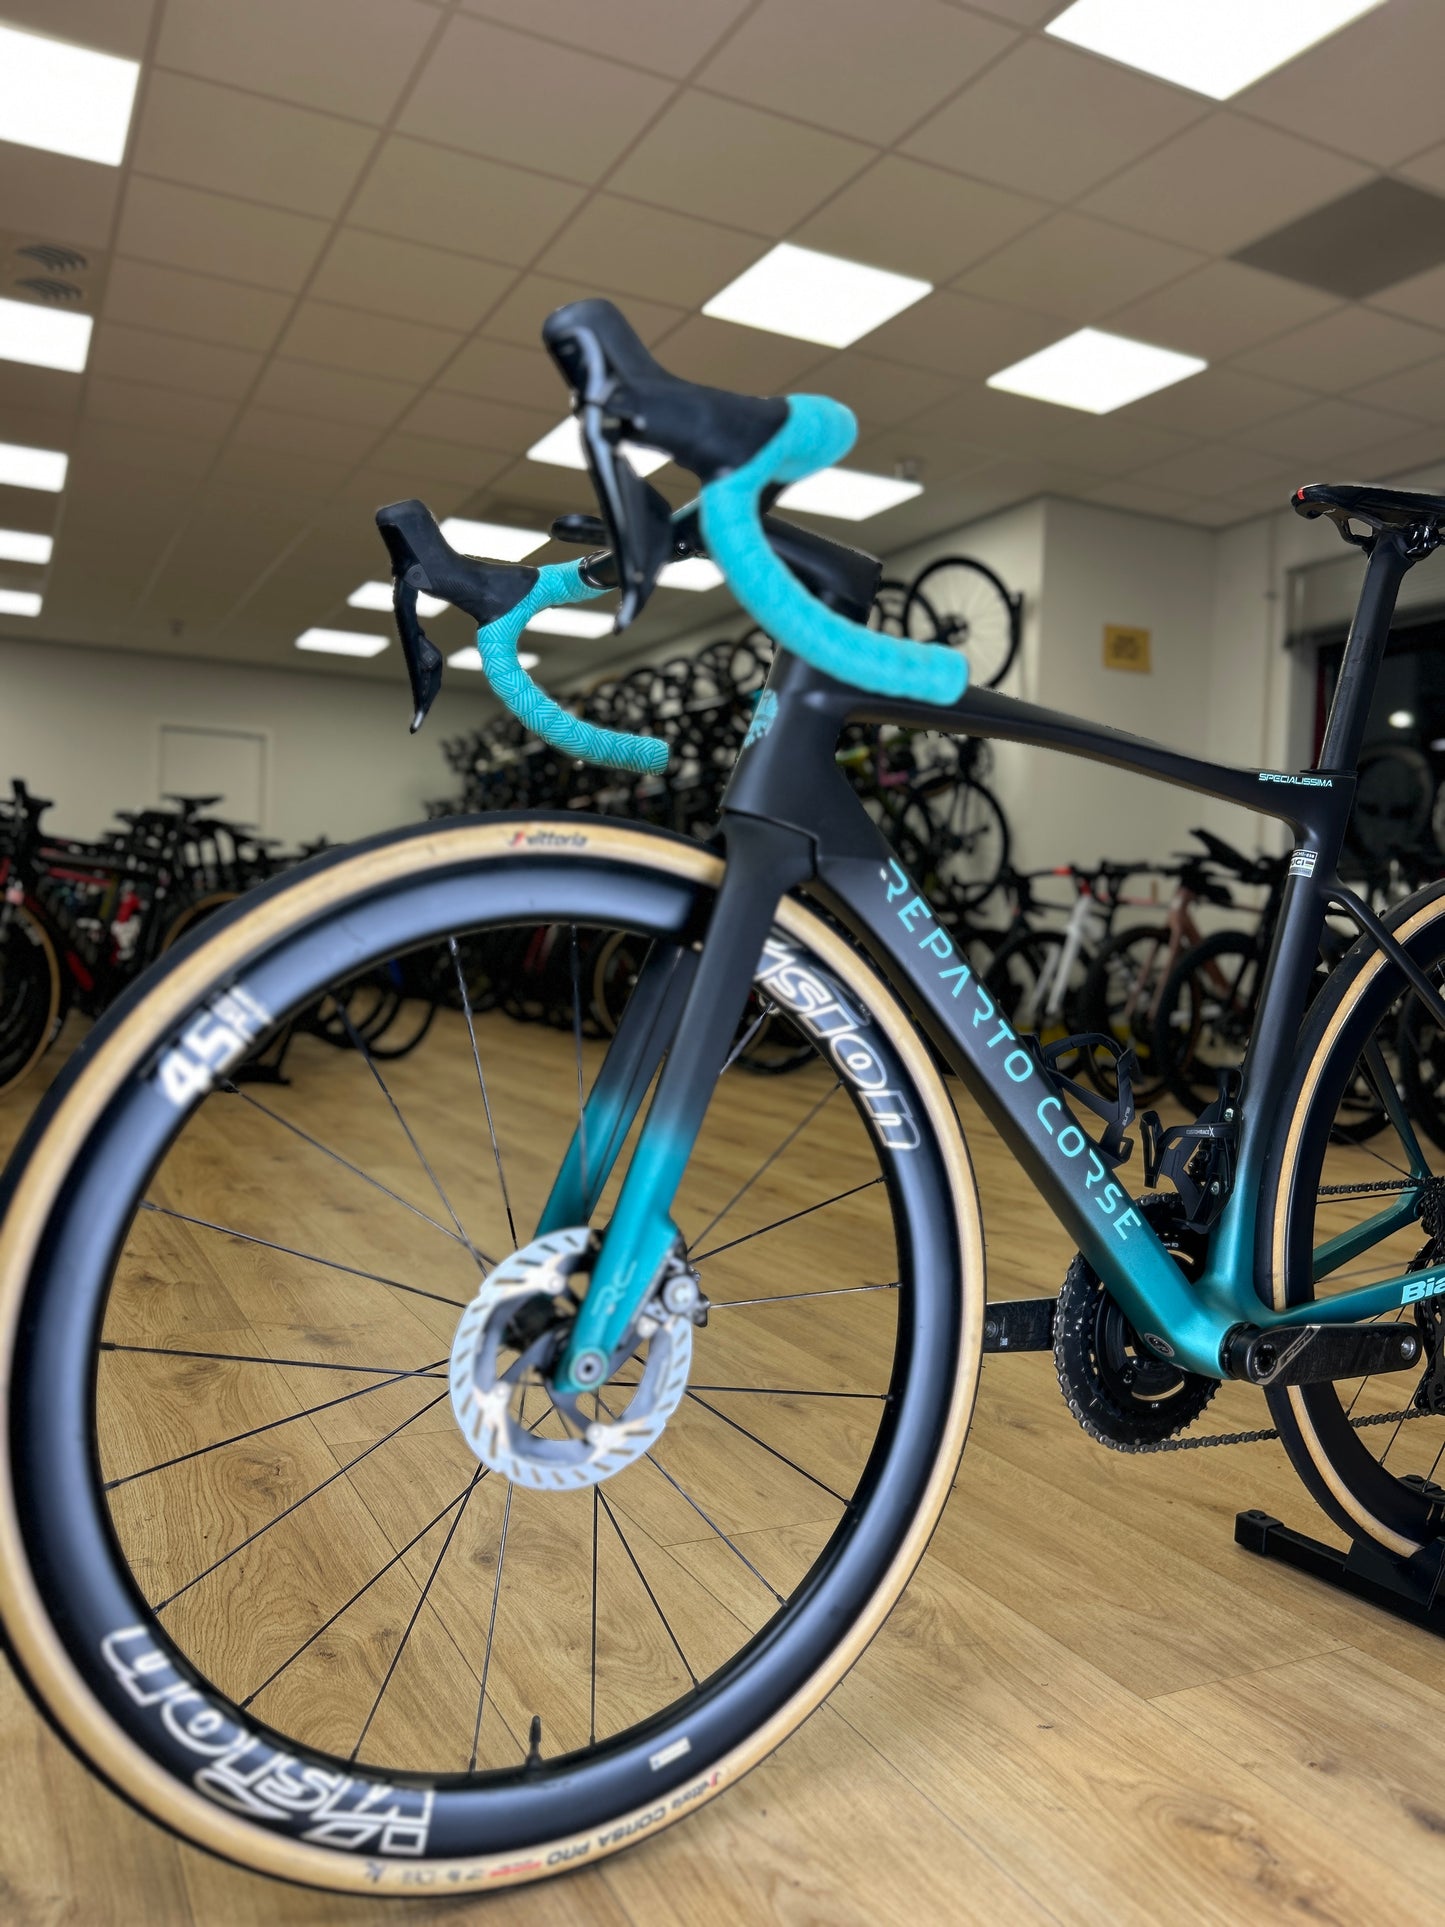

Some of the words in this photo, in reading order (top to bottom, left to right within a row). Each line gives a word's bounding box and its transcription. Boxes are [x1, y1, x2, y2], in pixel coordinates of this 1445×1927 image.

[1259, 773, 1333, 787] SPECIALISSIMA
[880, 857, 1034, 1083] REPARTO
[1037, 1096, 1142, 1241] CORSE
[598, 1805, 667, 1847] CORSA
[546, 1841, 592, 1867] PRO
